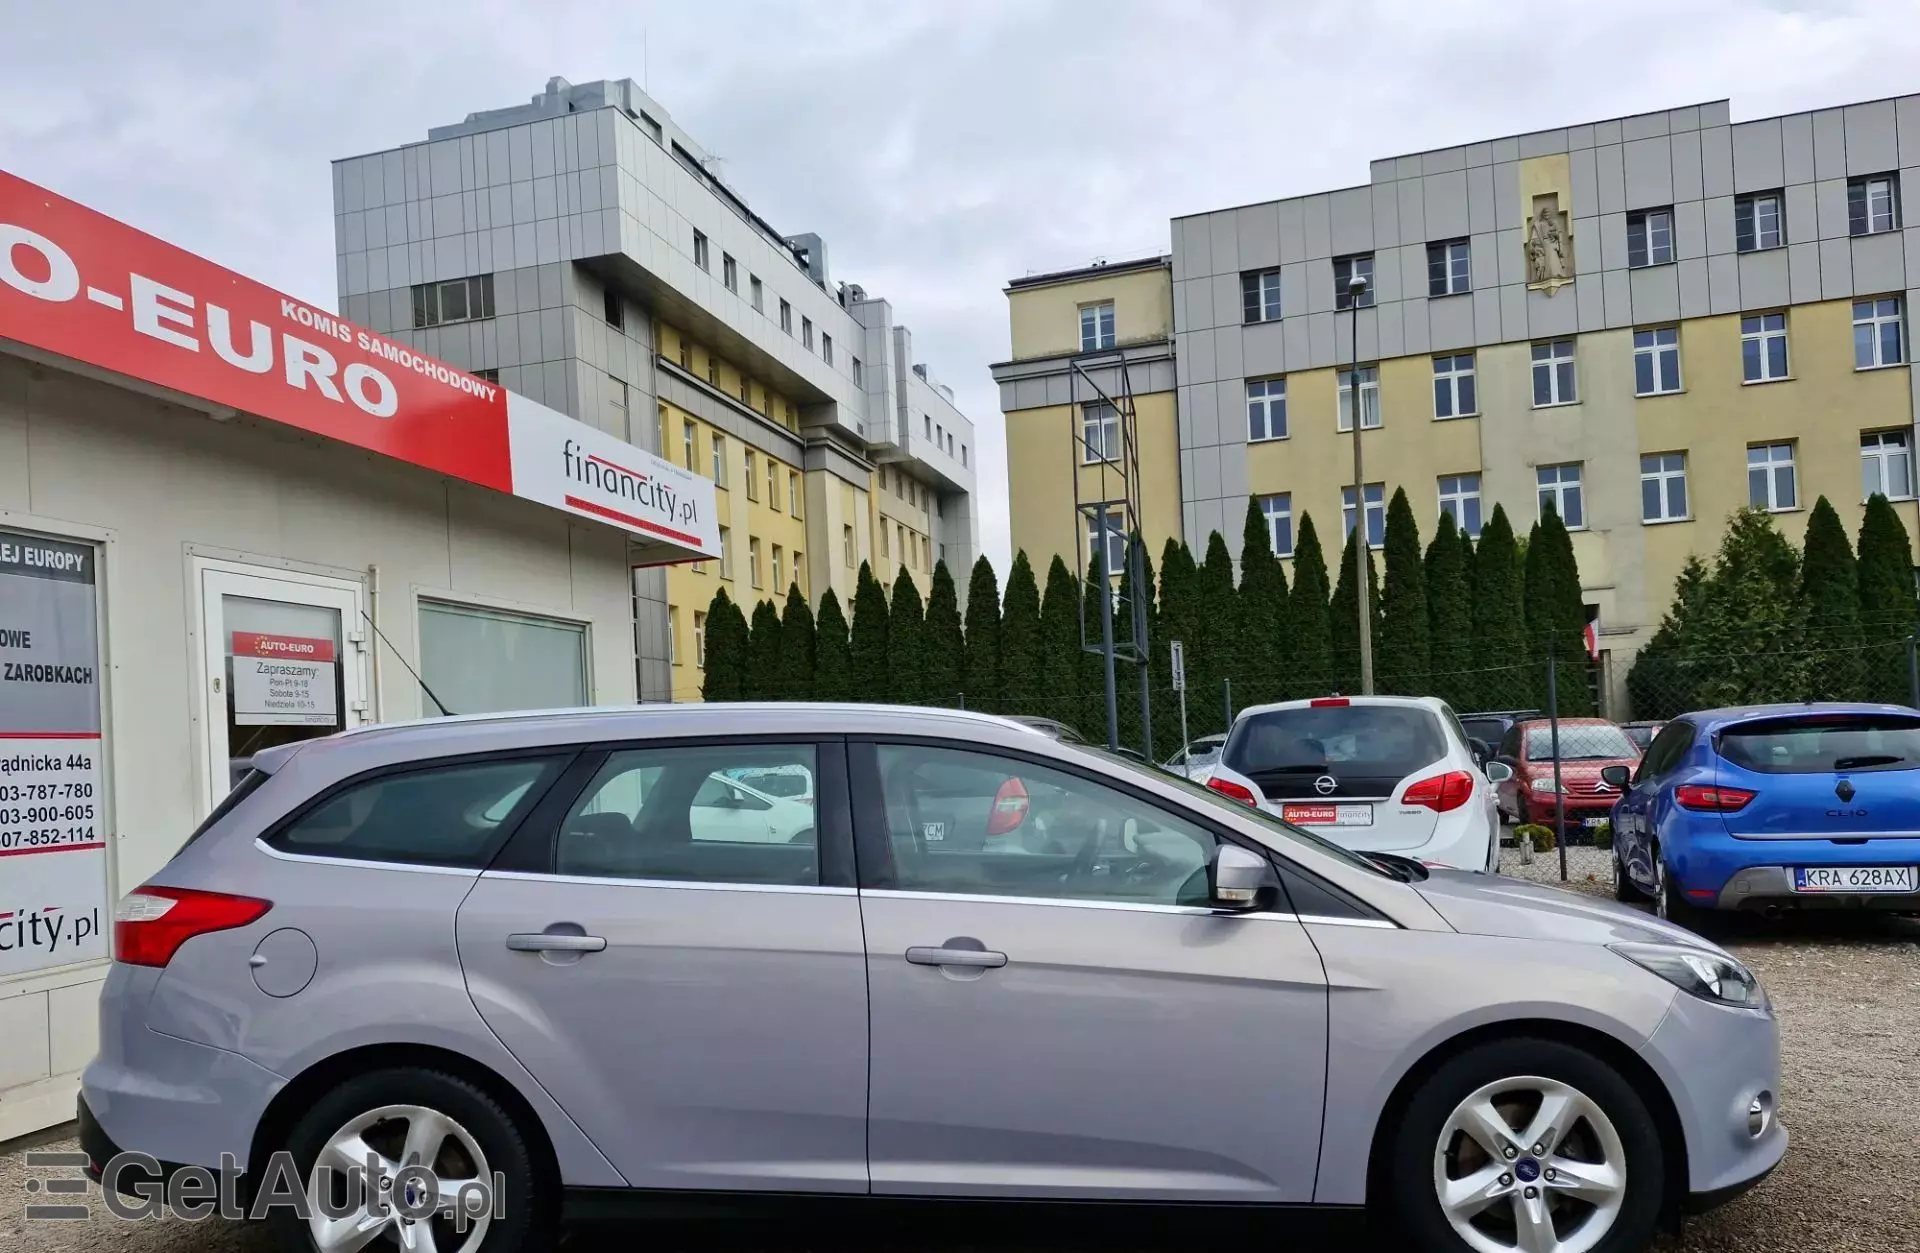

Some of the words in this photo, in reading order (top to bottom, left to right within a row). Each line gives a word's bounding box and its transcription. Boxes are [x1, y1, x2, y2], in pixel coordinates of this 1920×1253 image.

[0, 223, 398, 418] O-EURO
[280, 298, 352, 343] KOMIS
[357, 331, 496, 403] SAMOCHODOWY
[563, 439, 698, 526] financity.pl
[0, 543, 19, 564] EJ
[24, 546, 84, 572] EUROPY
[0, 629, 31, 648] OWE
[260, 641, 314, 654] AUTO-EURO
[4, 662, 93, 684] ZAROBKACH
[269, 688, 293, 698] Sobota
[0, 754, 62, 776] ądnicka
[66, 754, 92, 770] 44a
[0, 783, 93, 801] 03-787-780
[0, 805, 94, 825] 03-900-605
[1825, 809, 1868, 817] CLIO
[0, 826, 95, 848] 07-852-114
[1806, 870, 1842, 886] KRA
[1849, 869, 1907, 886] 628AX
